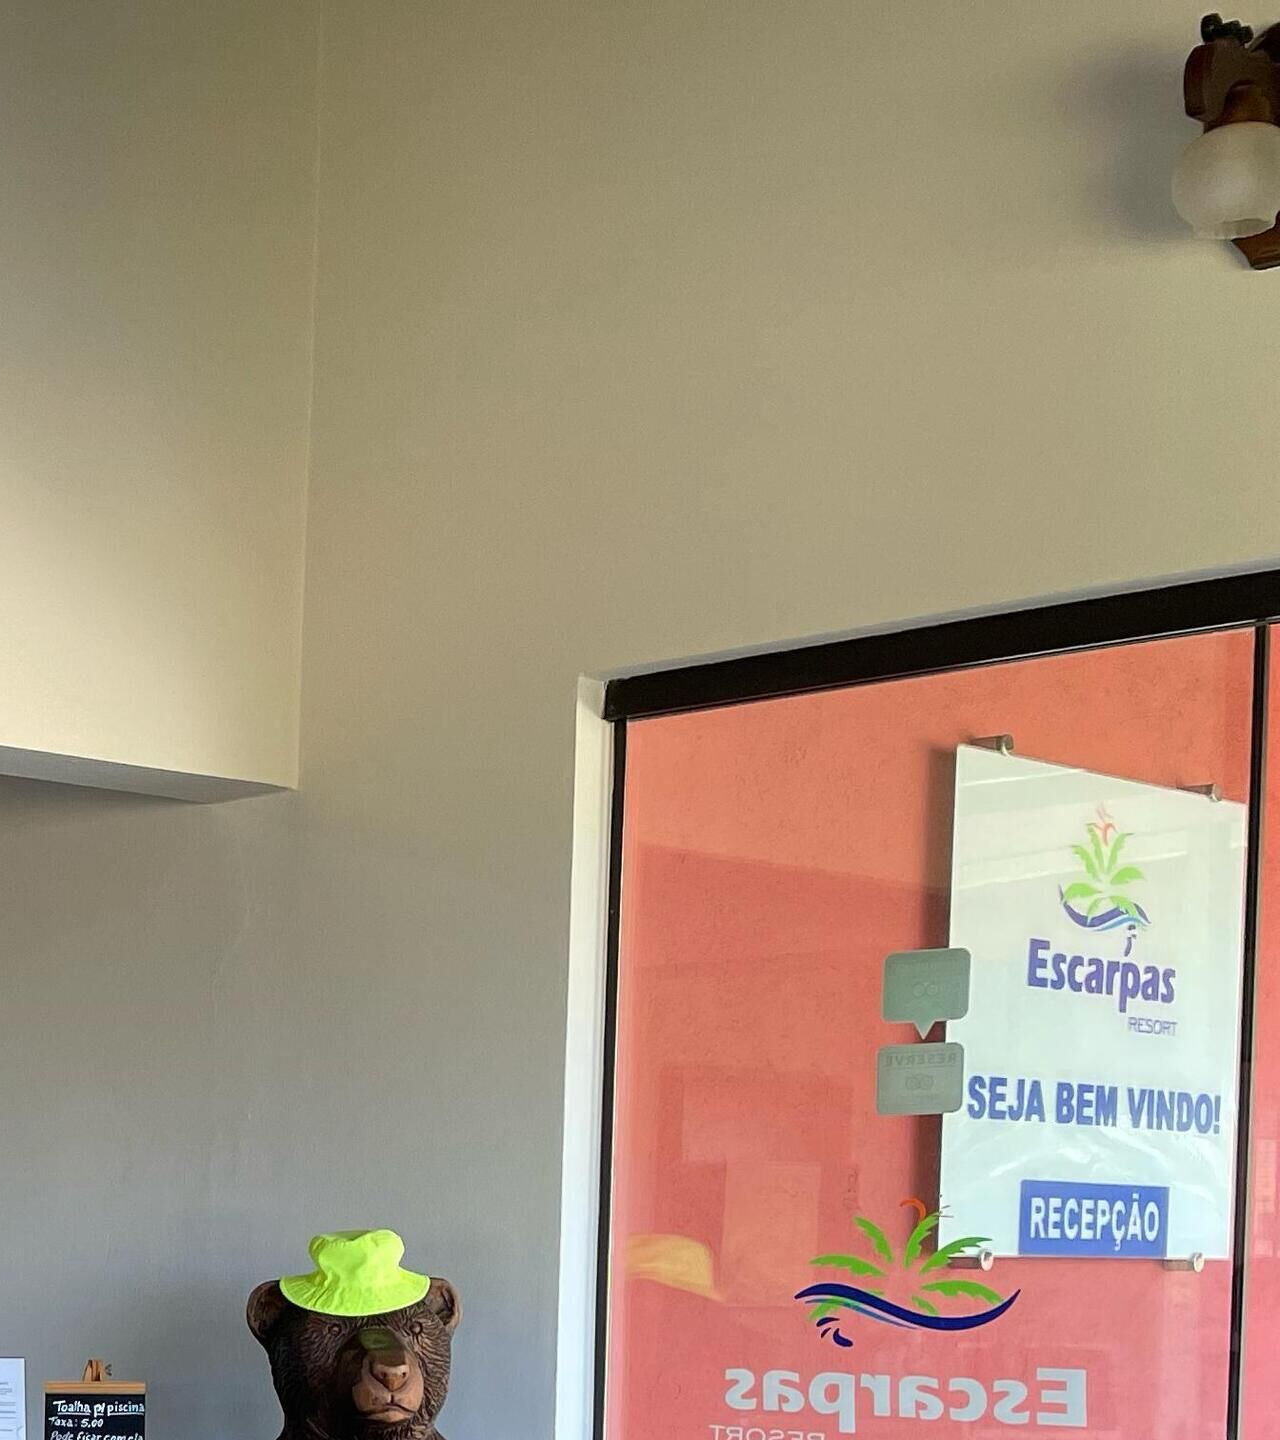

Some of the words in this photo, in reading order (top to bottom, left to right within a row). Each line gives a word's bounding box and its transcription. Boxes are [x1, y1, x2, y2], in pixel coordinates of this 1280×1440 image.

[1028, 938, 1177, 1013] Escarpas
[1128, 1017, 1178, 1036] RESORT
[967, 1075, 1046, 1123] SEJA
[1055, 1082, 1119, 1127] BEM
[1127, 1088, 1221, 1134] VINDO!
[1030, 1193, 1160, 1251] RECEPÇÃO
[53, 1400, 92, 1413] Toalha
[107, 1401, 145, 1416] piscina
